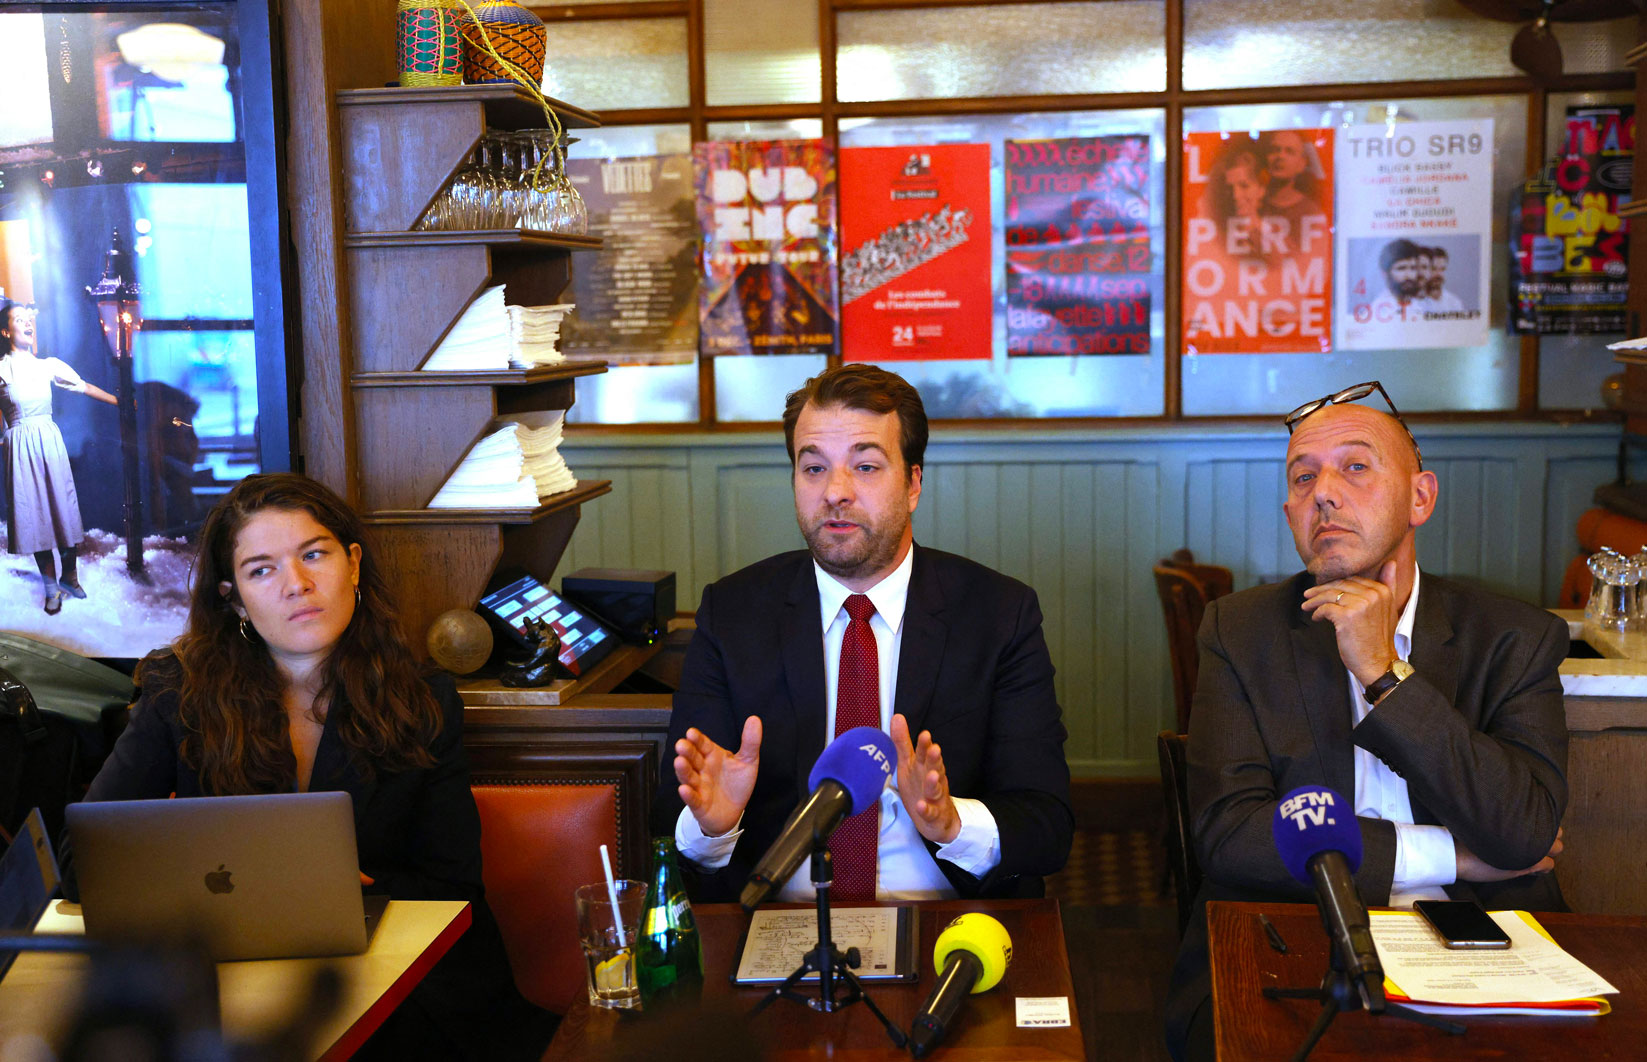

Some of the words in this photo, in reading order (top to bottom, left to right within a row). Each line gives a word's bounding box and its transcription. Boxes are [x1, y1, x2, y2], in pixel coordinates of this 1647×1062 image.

[1348, 135, 1416, 157] TRIO
[1427, 133, 1483, 156] SR9
[1188, 214, 1327, 256] PERF
[1126, 246, 1150, 273] 12
[1187, 258, 1325, 297] ORM
[1353, 278, 1367, 295] 4
[1186, 299, 1326, 338] ANCE
[1353, 299, 1417, 324] OCT.
[892, 326, 914, 342] 24
[859, 743, 891, 774] AFP
[1280, 791, 1335, 820] BFM
[1289, 806, 1336, 831] TV.
